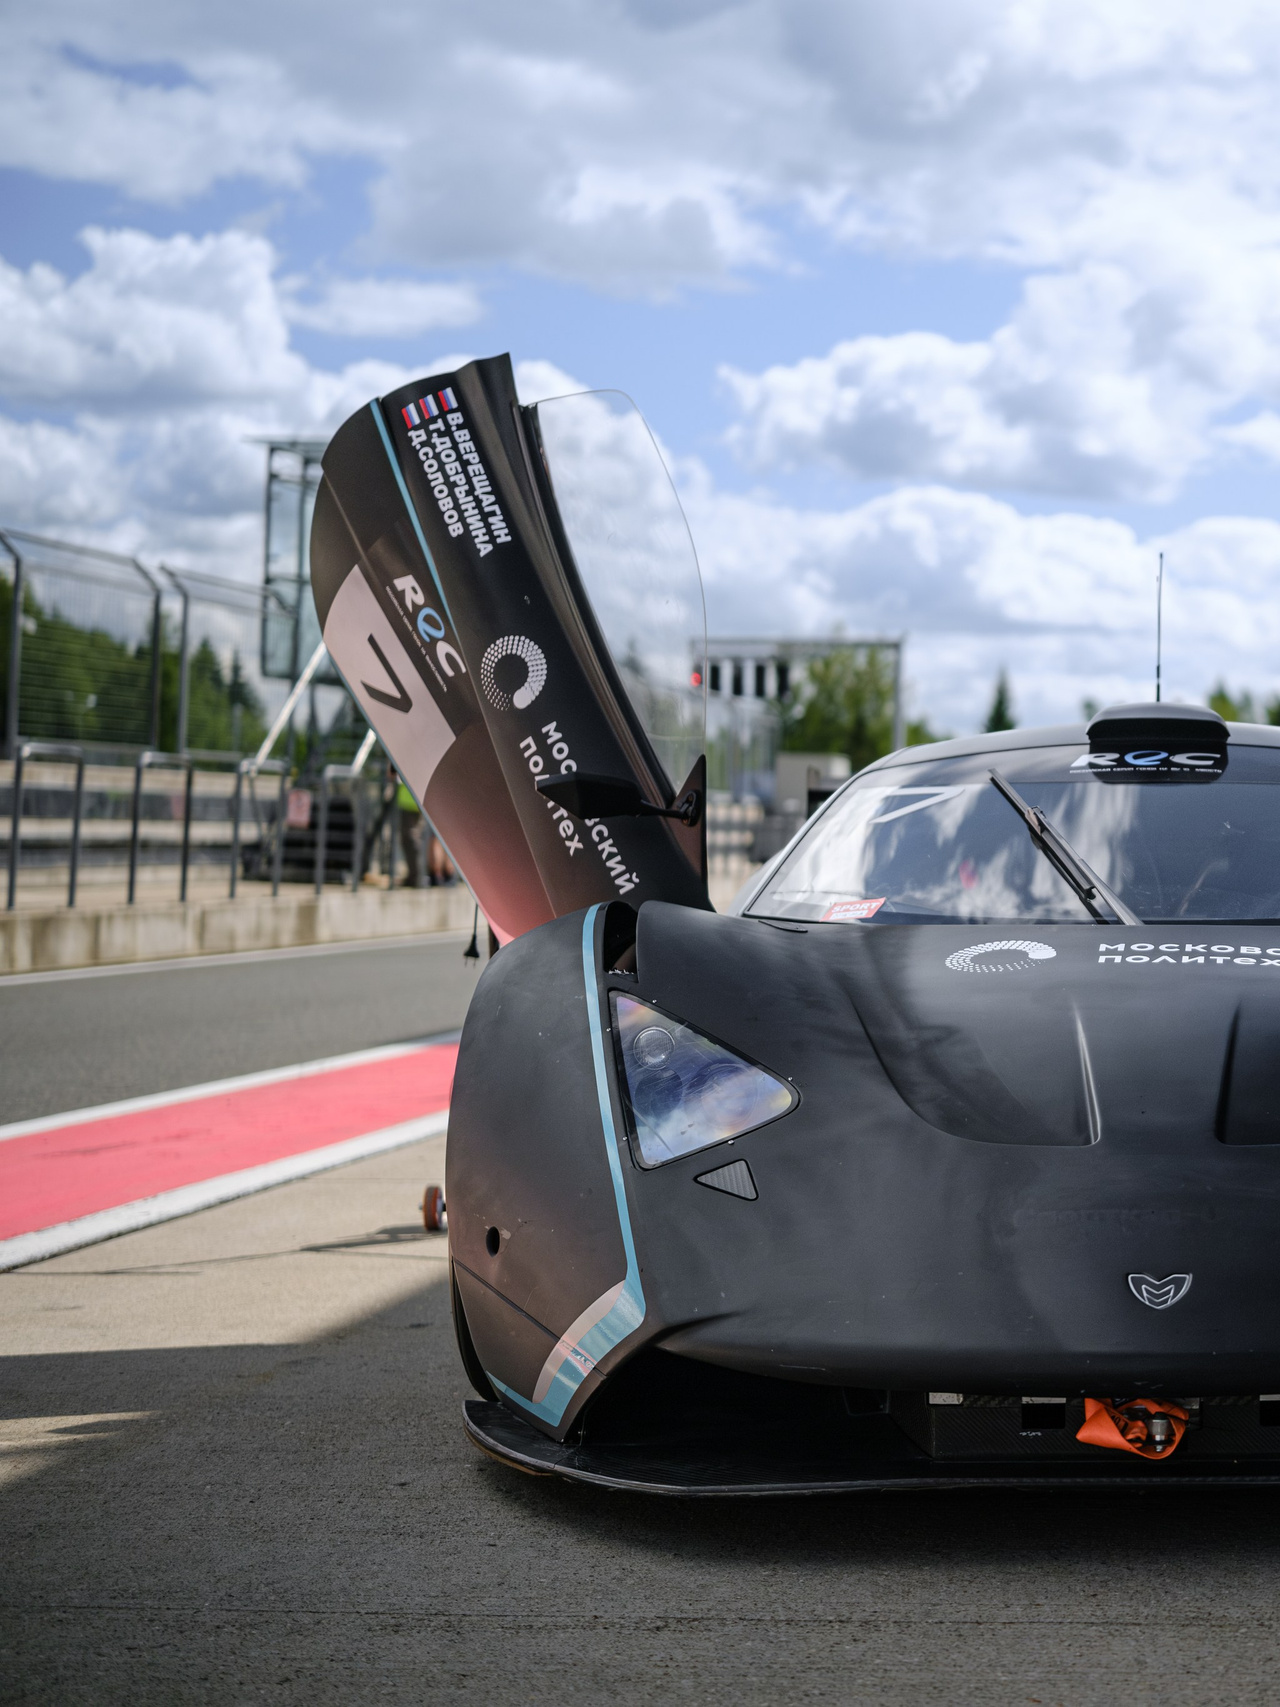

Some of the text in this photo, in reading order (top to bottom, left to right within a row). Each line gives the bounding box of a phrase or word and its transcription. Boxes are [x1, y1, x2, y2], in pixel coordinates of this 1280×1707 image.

[407, 428, 464, 538] Д.СОЛОВОВ
[428, 418, 494, 558] Т.ДОБРЫНИНА
[446, 411, 512, 544] В.ВЕРЕЩАГИН
[360, 632, 413, 714] 7
[541, 720, 640, 895] МОССКИЙ
[831, 902, 881, 913] SPORT
